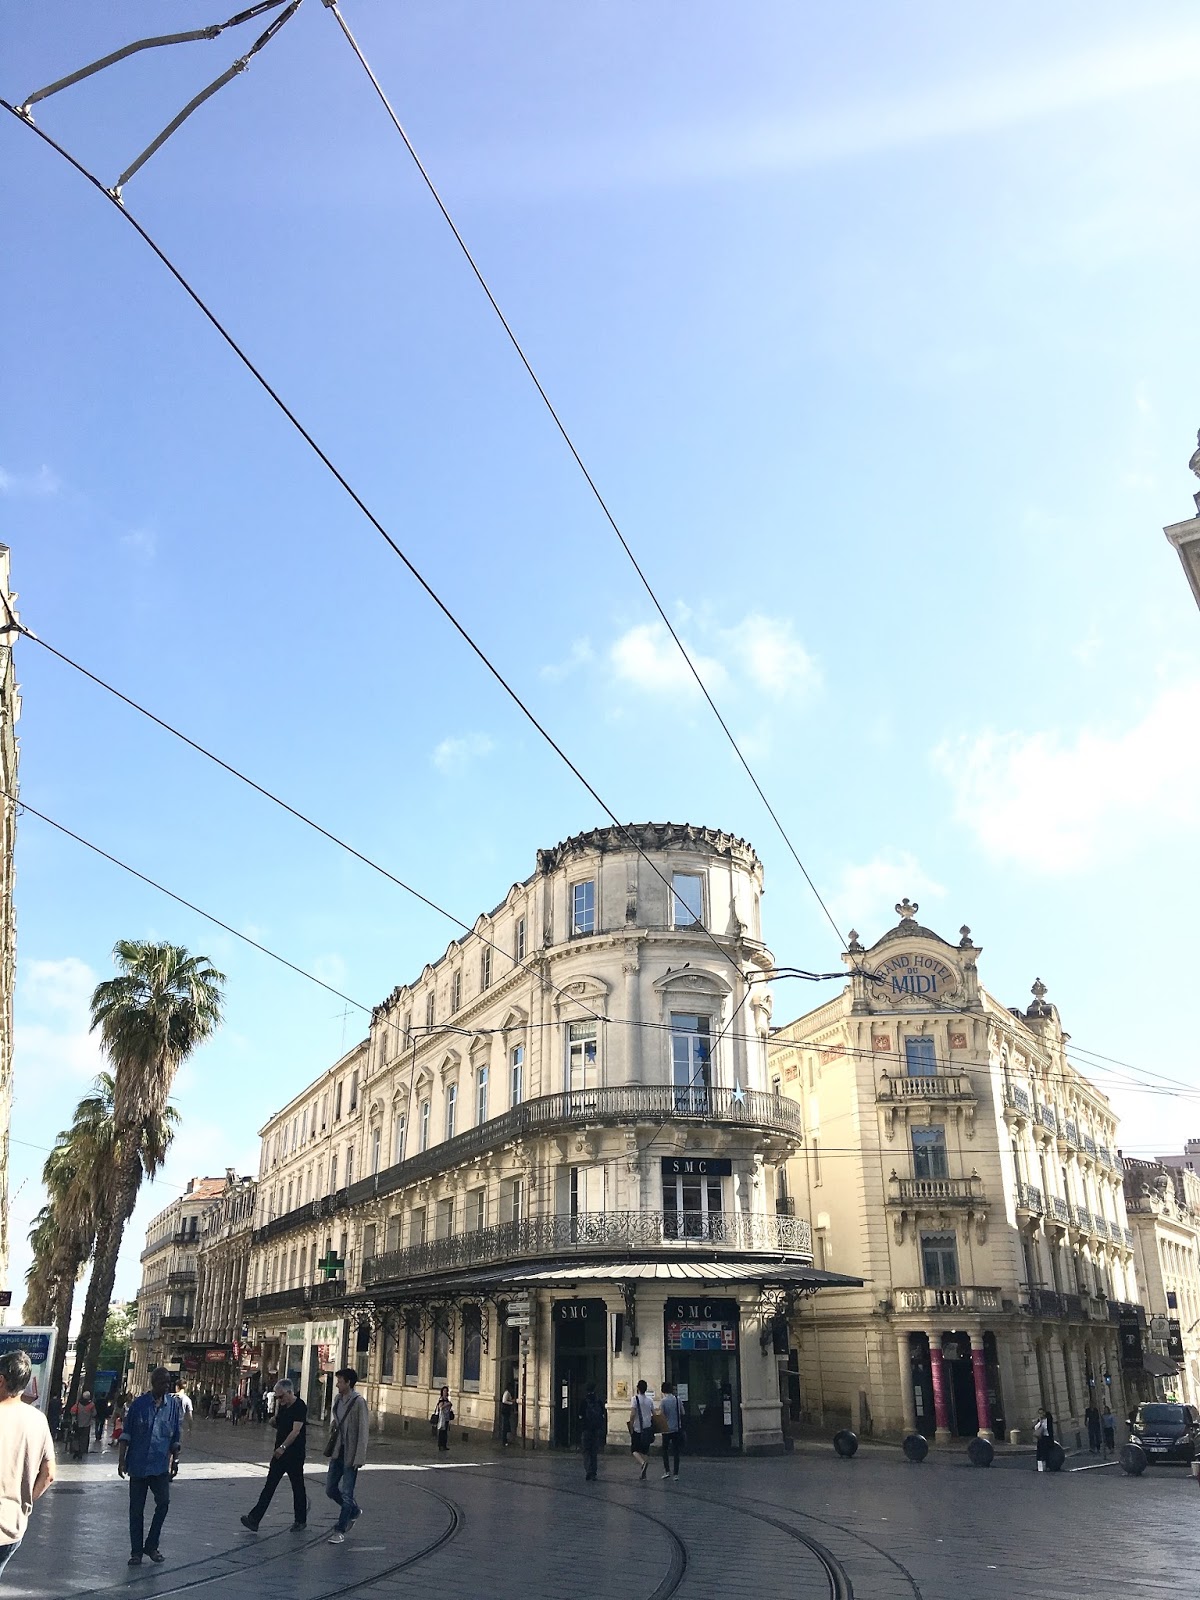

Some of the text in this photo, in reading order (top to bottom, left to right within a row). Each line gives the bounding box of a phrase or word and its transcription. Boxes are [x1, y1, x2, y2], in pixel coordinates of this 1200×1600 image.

[914, 956, 952, 983] HOTEL
[891, 974, 937, 994] MIDI
[681, 1331, 721, 1339] CHANGE
